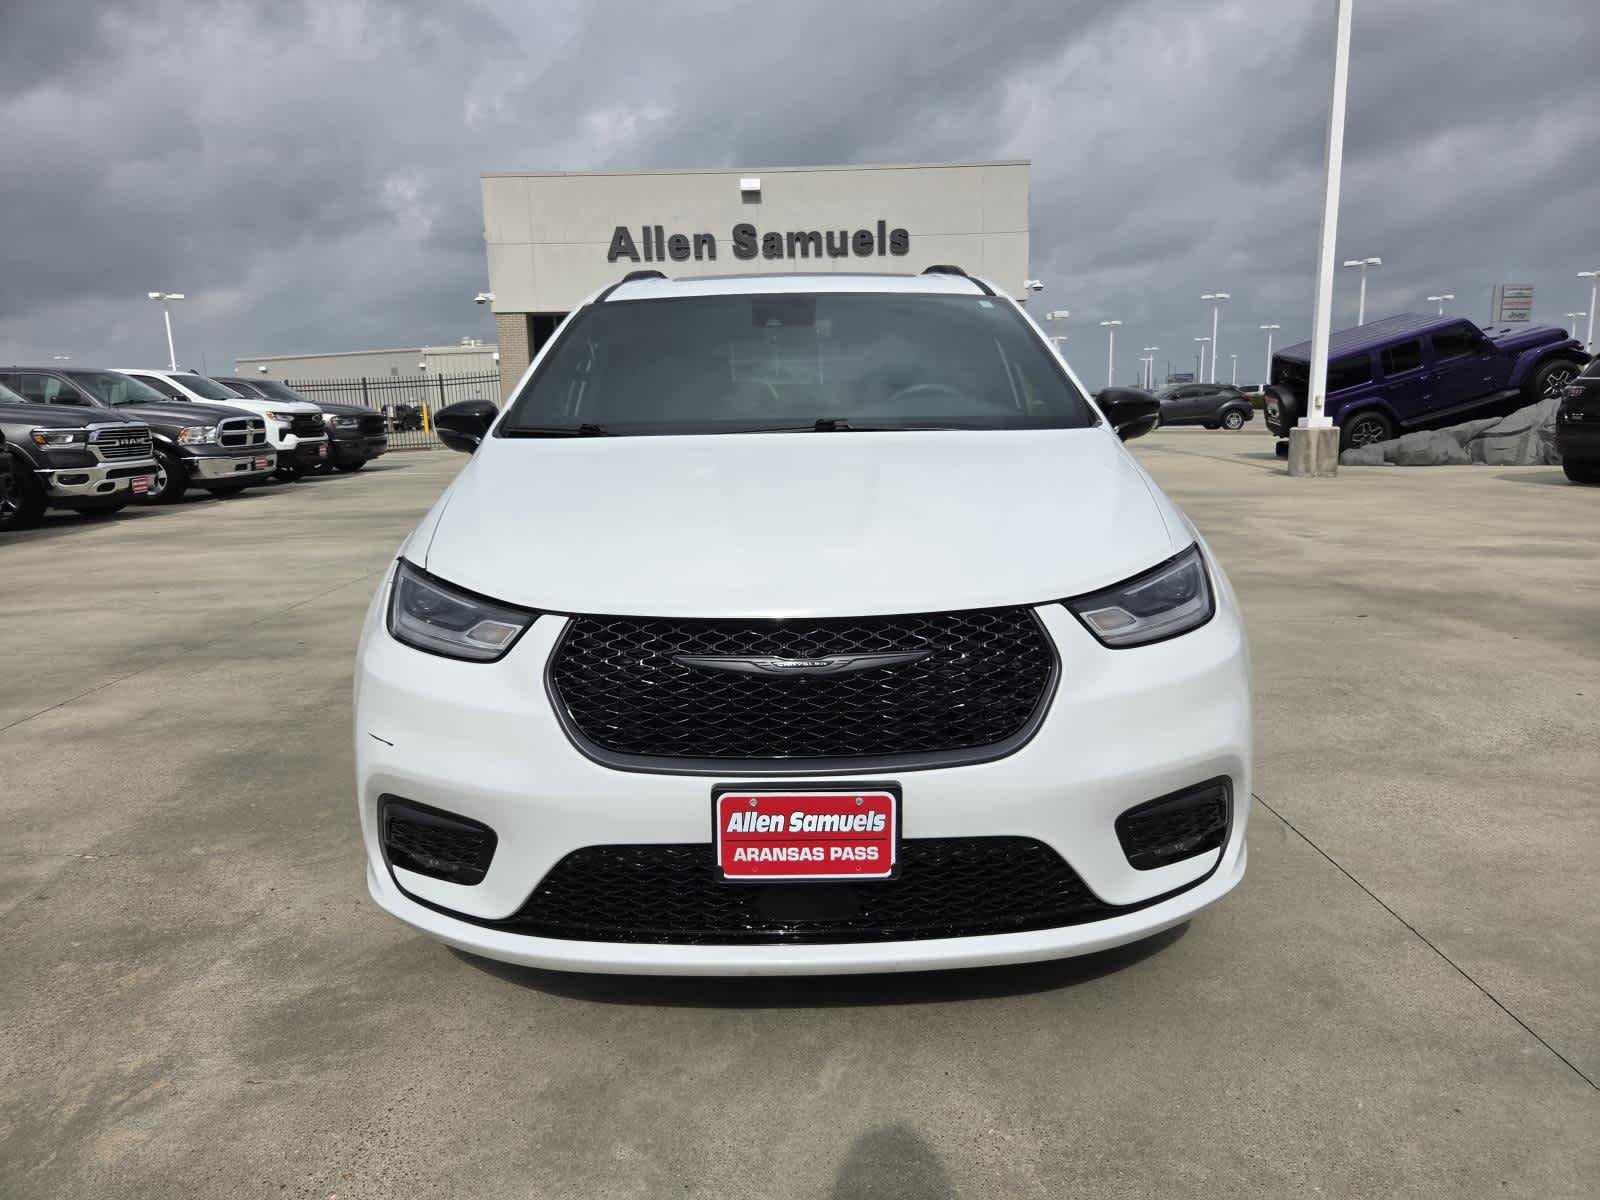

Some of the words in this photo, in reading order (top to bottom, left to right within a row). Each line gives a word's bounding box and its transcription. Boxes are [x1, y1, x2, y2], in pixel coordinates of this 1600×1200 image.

[607, 226, 717, 263] Allen
[732, 219, 910, 260] Samuels
[727, 812, 785, 833] Allen
[788, 811, 886, 832] Samuels
[733, 847, 825, 862] ARANSAS
[830, 846, 880, 861] PASS
